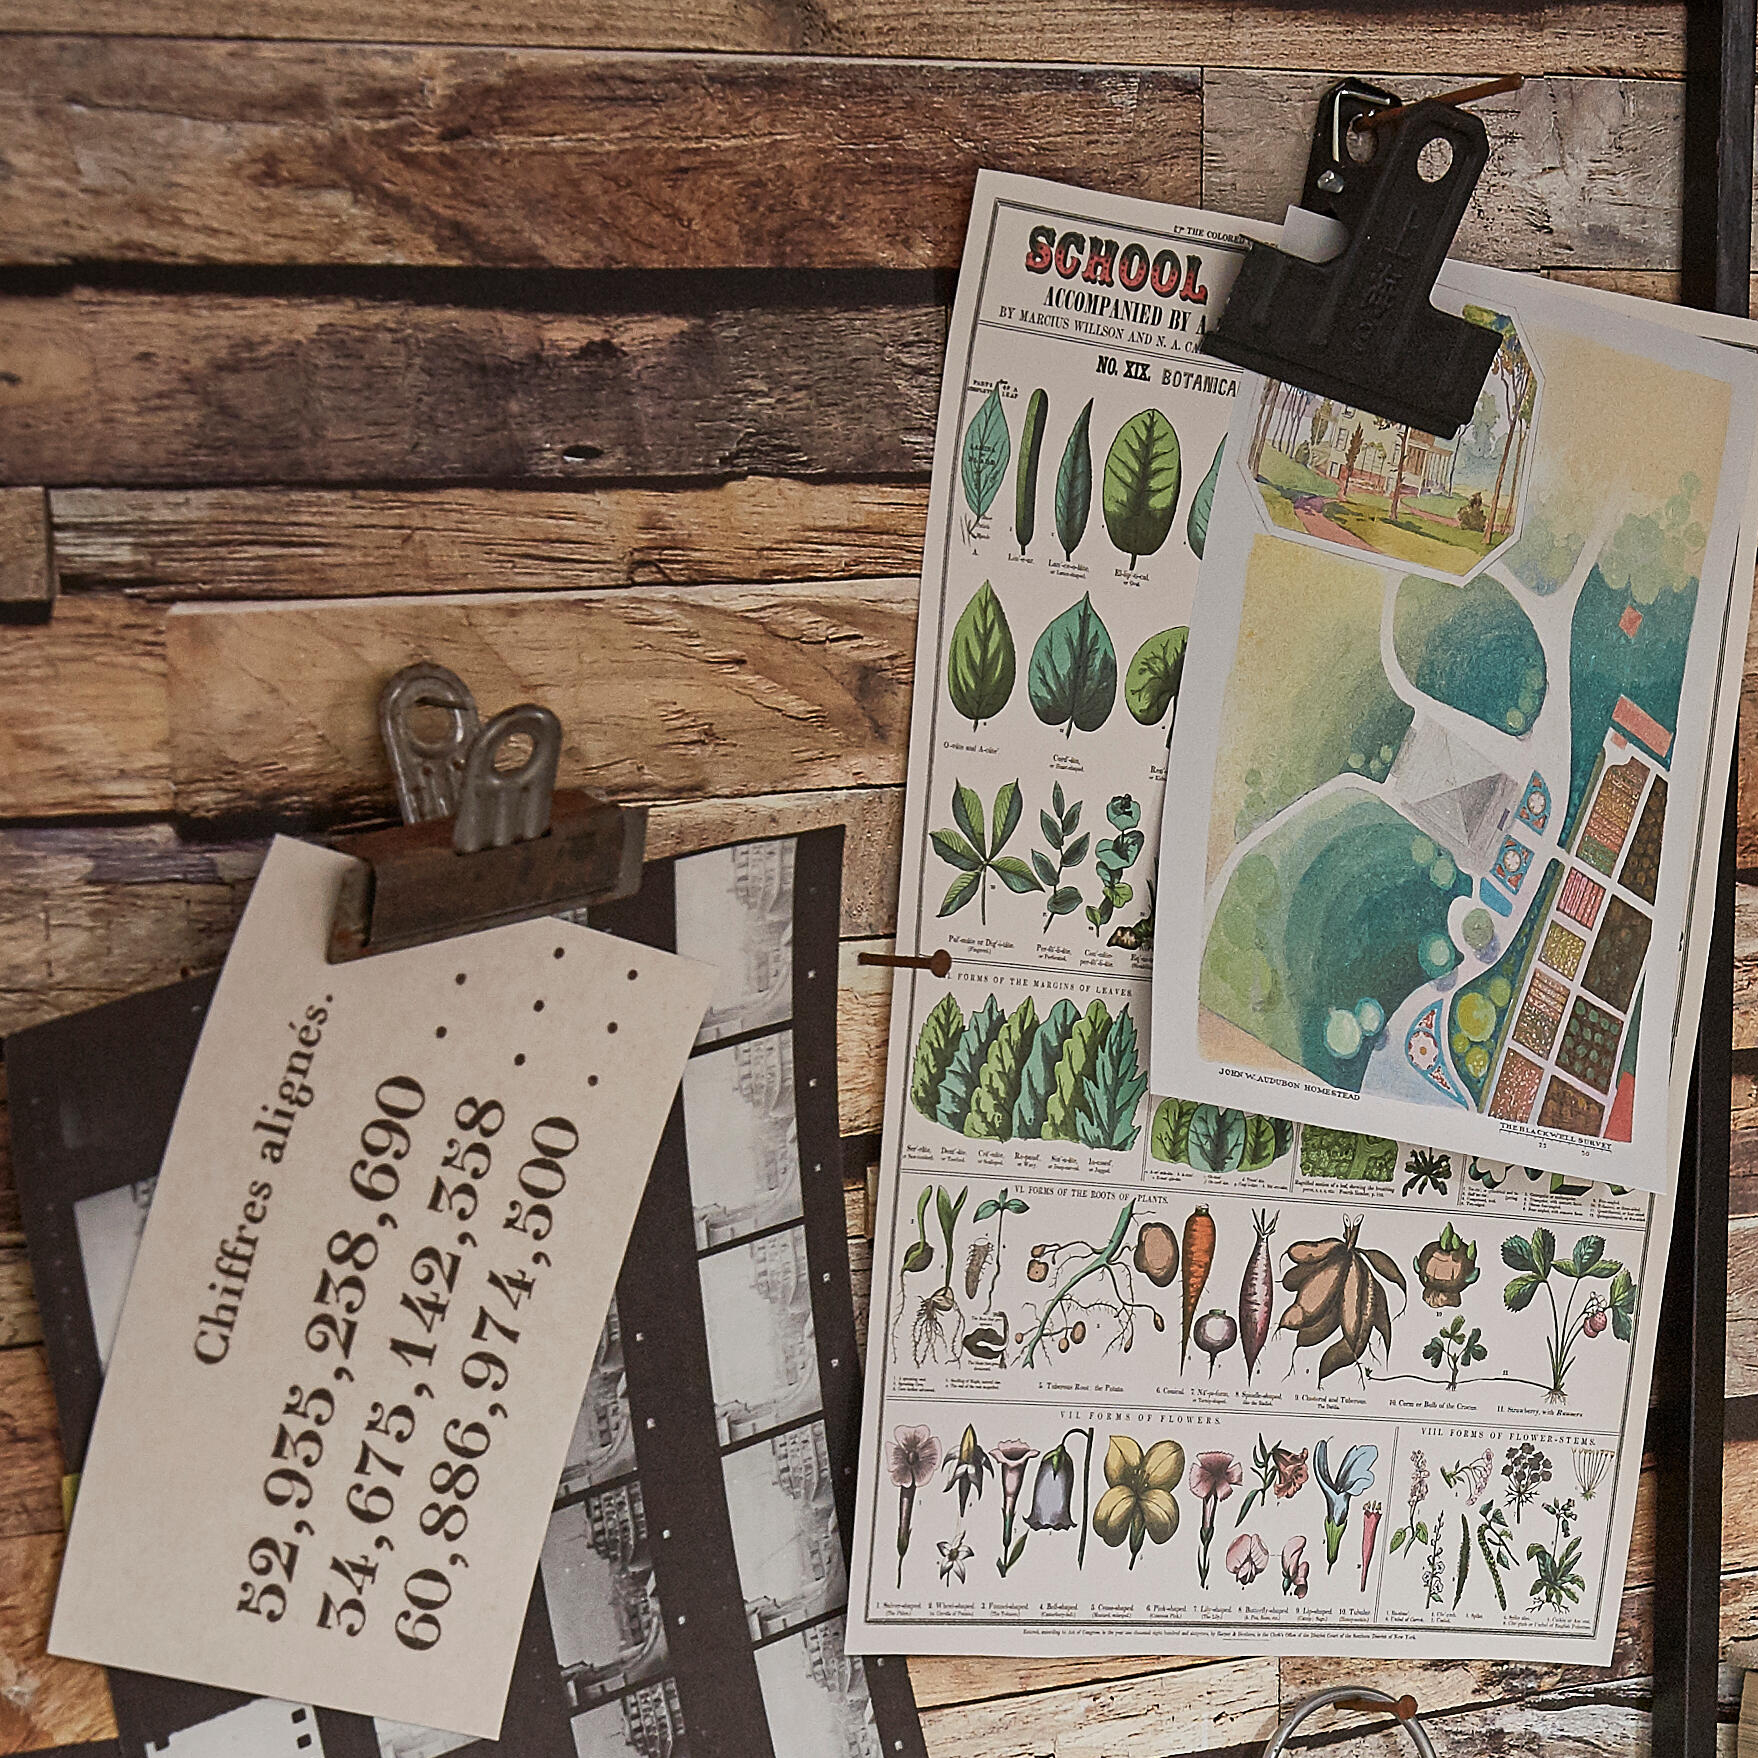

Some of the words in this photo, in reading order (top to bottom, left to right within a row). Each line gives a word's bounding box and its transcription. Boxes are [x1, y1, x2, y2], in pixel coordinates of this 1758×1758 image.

[1187, 226, 1204, 236] THE
[1024, 225, 1209, 306] SCHOOL
[999, 305, 1016, 320] BY
[1019, 309, 1070, 330] MARCIUS
[1074, 319, 1125, 340] WILLSON
[1127, 330, 1153, 346] AND
[1155, 335, 1168, 349] N.
[1170, 338, 1183, 351] A.
[1043, 286, 1163, 328] ACCOMPANIED
[1168, 308, 1192, 333] BY
[1096, 355, 1119, 376] NO.
[1122, 358, 1151, 382] XIX.
[1161, 368, 1241, 398] BOTANICA
[957, 972, 989, 983] FORMS
[992, 976, 1006, 985] OF
[1009, 978, 1029, 987] THE
[1033, 979, 1076, 992] MARGINS
[1079, 984, 1092, 993] OF
[1218, 1067, 1243, 1078] JOHN
[1303, 1084, 1361, 1102] HOMESTEAD
[1500, 1122, 1518, 1131] THE
[1519, 1124, 1577, 1143] BLACKWELL
[1578, 1137, 1613, 1150] SURVEY
[193, 1178, 273, 1366] Chiffres
[253, 993, 334, 1165] alignés.
[1028, 1186, 1054, 1196] FORMS
[1057, 1188, 1068, 1197] OF
[1071, 1189, 1088, 1198] THE
[1090, 1190, 1117, 1201] ROOTS
[1119, 1192, 1130, 1201] OF
[236, 1074, 426, 1623] 52,935,238,690
[316, 1096, 506, 1638] 34,675,142,358
[394, 1116, 580, 1652] 60,886,974,500
[1089, 1412, 1131, 1422] FORMS
[1138, 1414, 1153, 1422] OF
[1449, 1429, 1484, 1439] FORMS
[1489, 1431, 1503, 1440] OF
